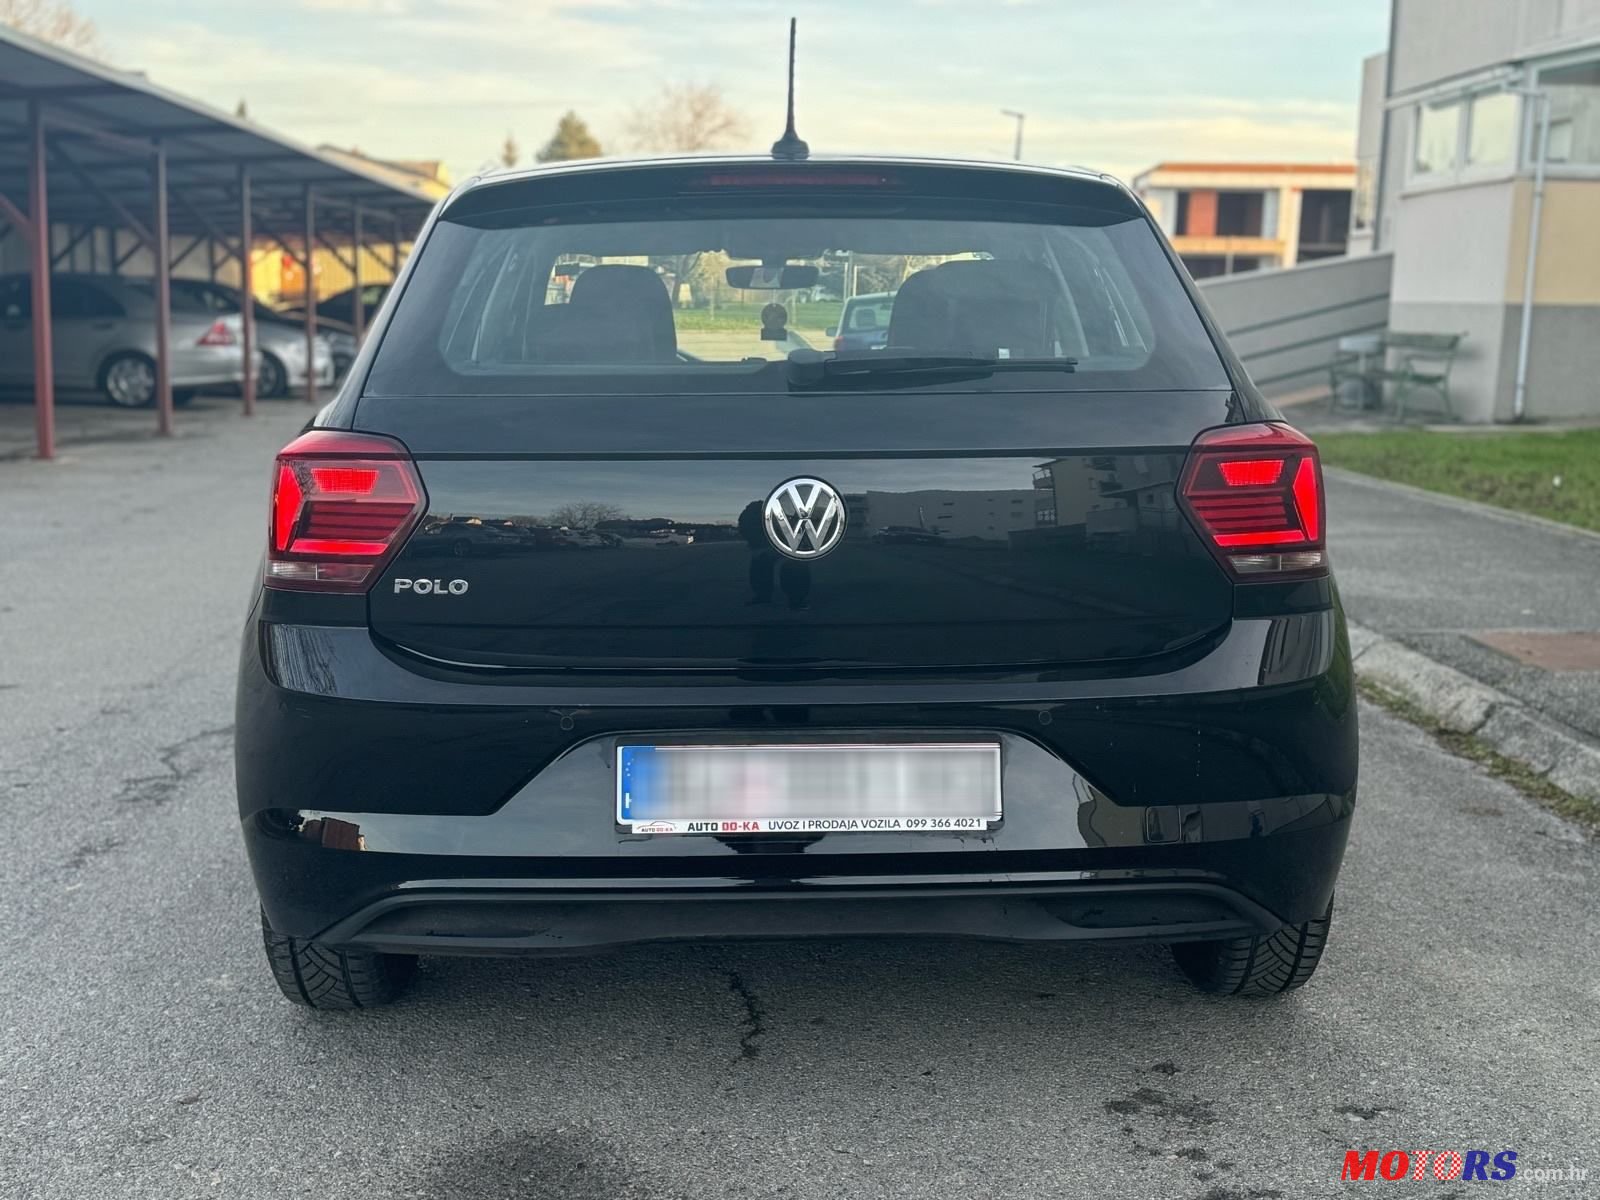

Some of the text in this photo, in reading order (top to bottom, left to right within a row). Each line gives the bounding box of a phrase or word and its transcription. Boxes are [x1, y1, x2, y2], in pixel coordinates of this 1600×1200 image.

[394, 578, 469, 595] POLO
[688, 822, 718, 832] AUTO
[768, 820, 800, 831] UVOZ
[808, 819, 858, 831] PRODAJA
[861, 819, 901, 829] VOZILA
[906, 818, 927, 828] 099
[930, 818, 951, 828] 366
[954, 818, 981, 828] 4021
